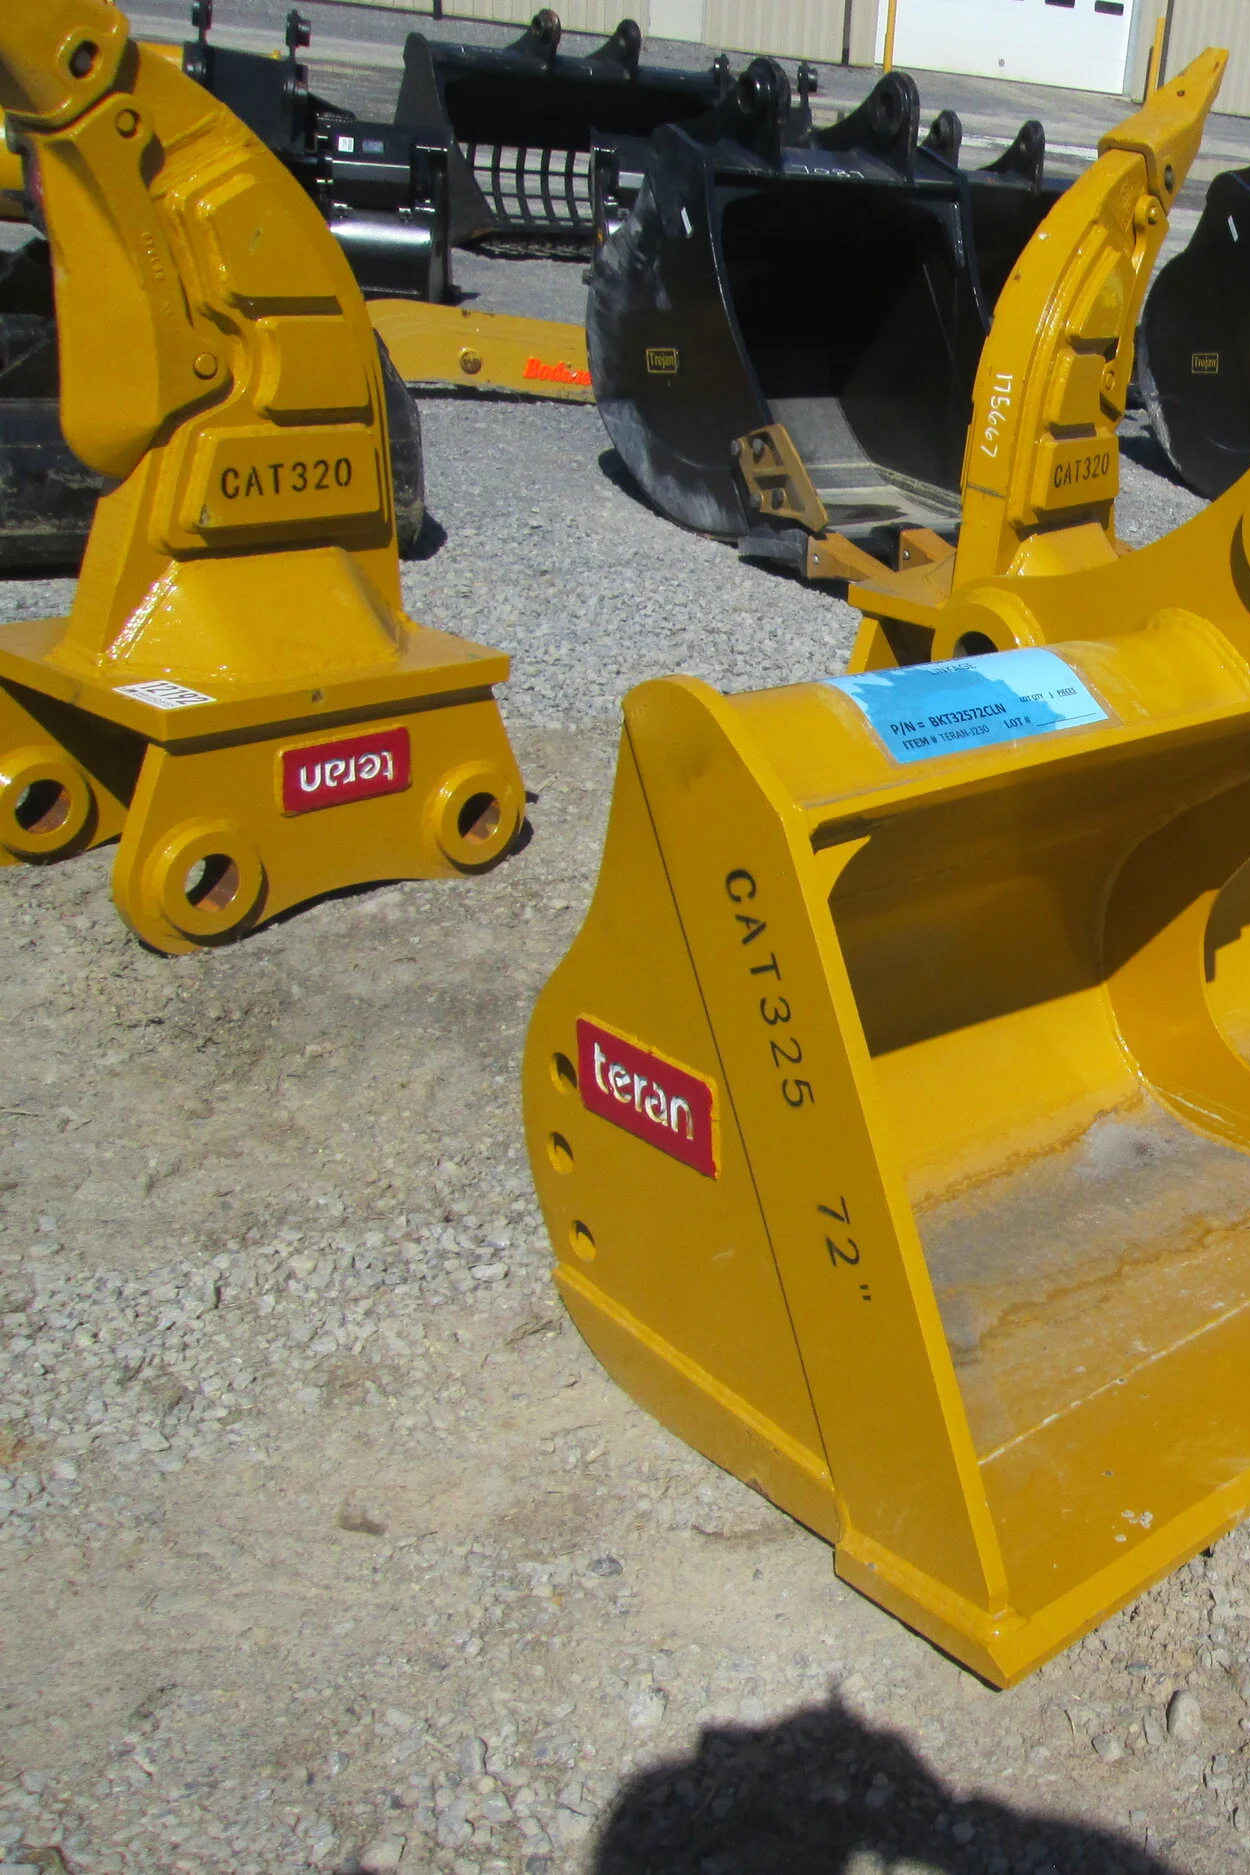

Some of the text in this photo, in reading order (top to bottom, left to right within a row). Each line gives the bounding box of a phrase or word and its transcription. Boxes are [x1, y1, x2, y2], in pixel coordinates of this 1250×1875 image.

[649, 351, 675, 369] Trojan
[1194, 356, 1216, 370] Trojan
[980, 372, 1014, 458] 175667
[220, 457, 353, 500] CAT320
[1053, 451, 1111, 489] CAT320
[139, 682, 210, 706] 12192
[1056, 686, 1079, 699] PIECES
[889, 719, 917, 737] P/N
[927, 702, 1008, 729] BKT32572CLN
[902, 723, 991, 751] ITEM # TERAN-J230
[1003, 716, 1032, 730] LOT #
[298, 748, 395, 793] teran
[725, 868, 815, 1109] CAT325
[593, 1040, 695, 1141] teran
